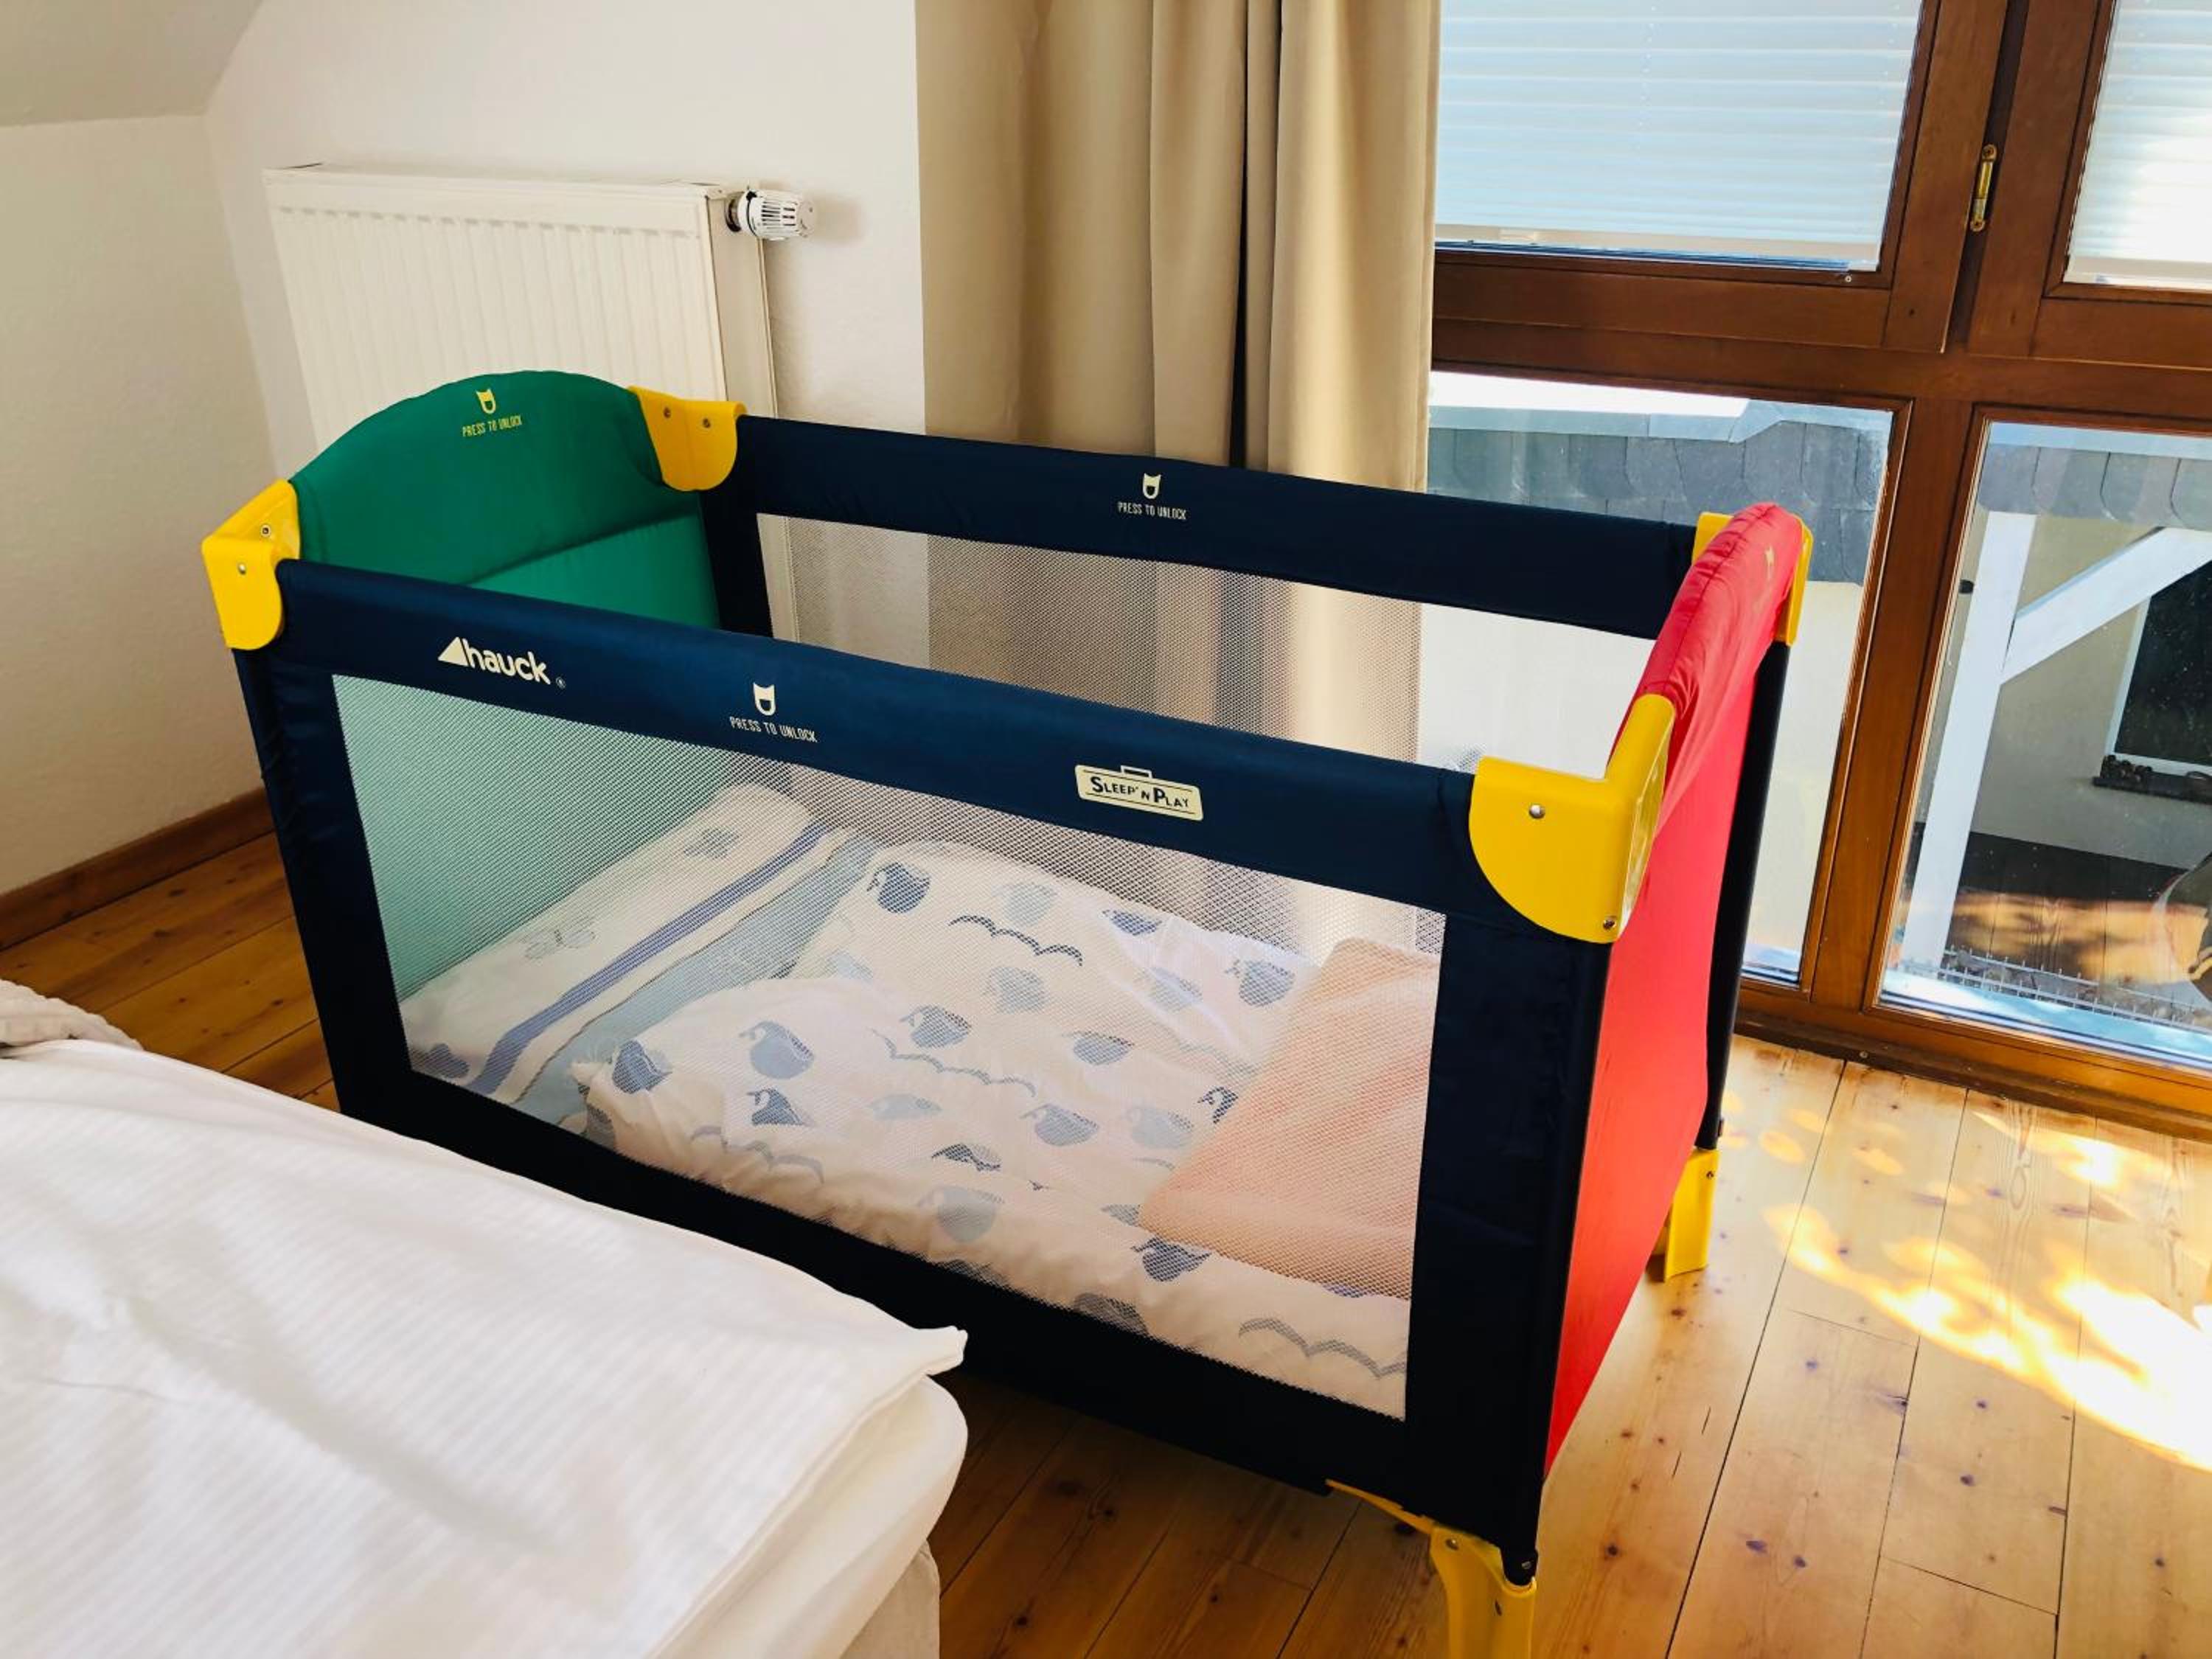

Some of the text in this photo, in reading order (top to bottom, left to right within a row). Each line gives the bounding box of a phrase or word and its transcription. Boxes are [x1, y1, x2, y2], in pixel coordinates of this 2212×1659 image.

[462, 414, 522, 437] PRESS TO UNLOCK
[1118, 501, 1186, 520] PRESS TO UNLOCK
[462, 638, 551, 685] hauck
[729, 716, 818, 743] PRESS TO UNLOCK
